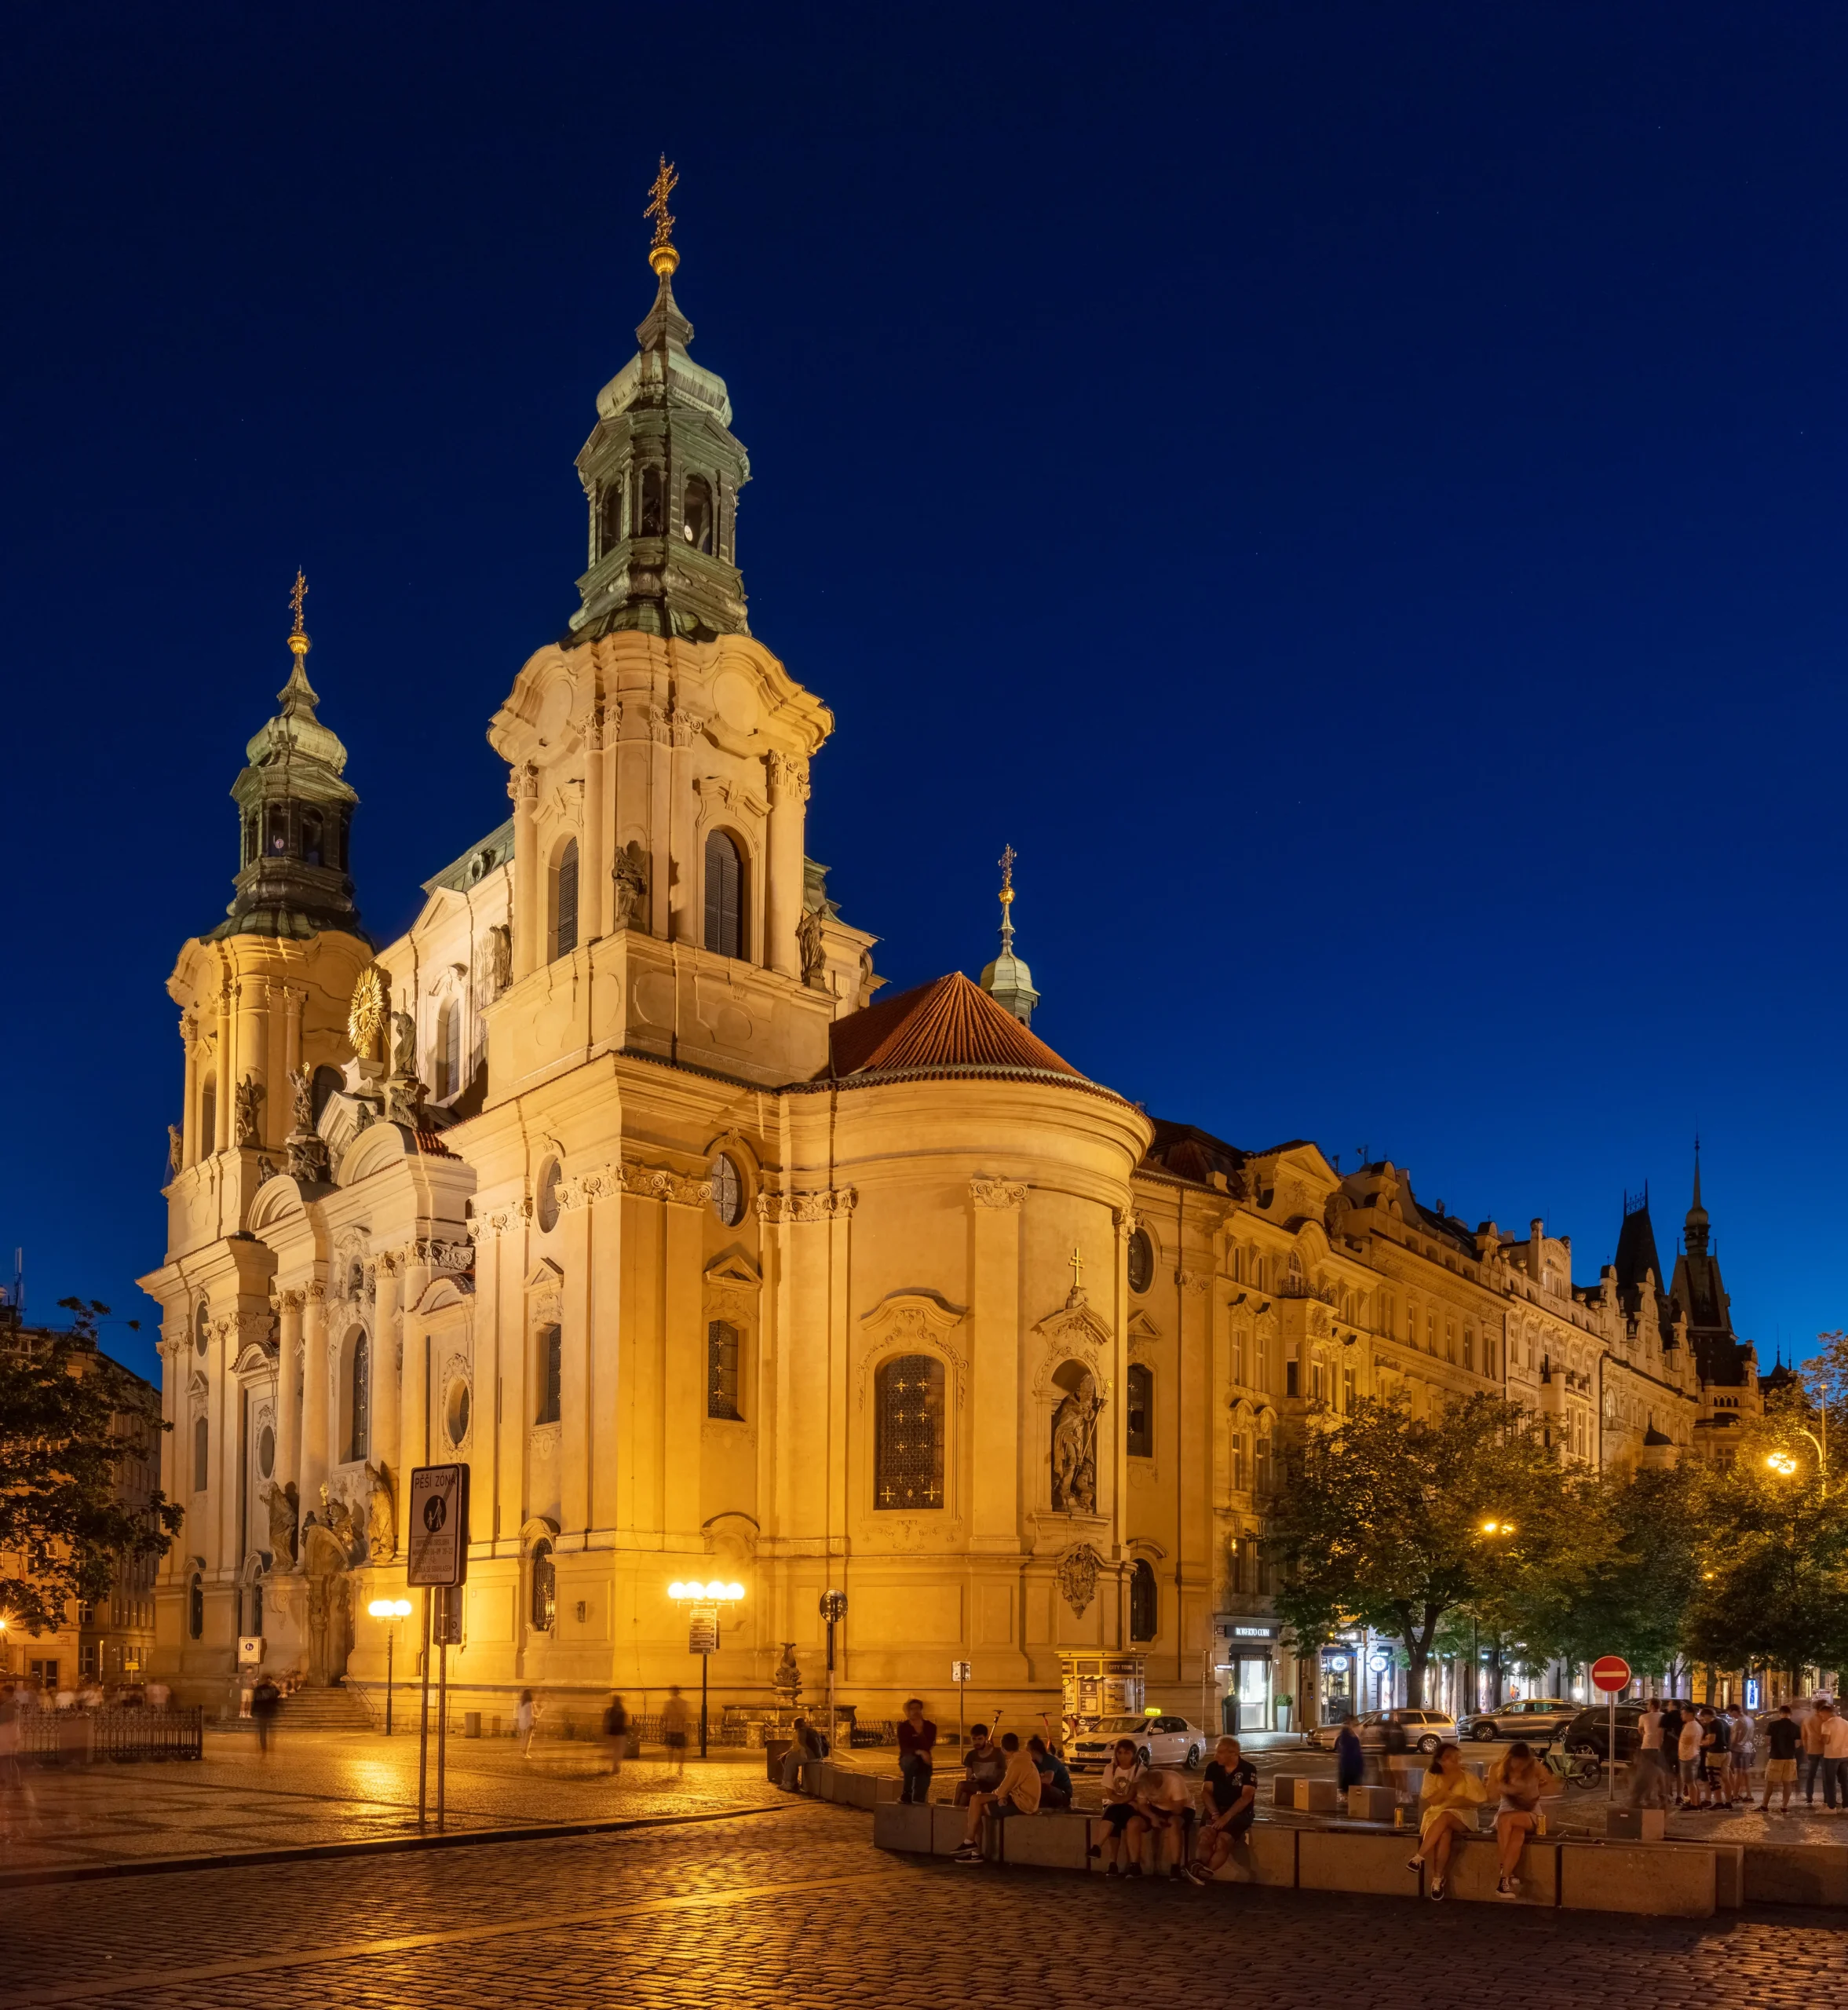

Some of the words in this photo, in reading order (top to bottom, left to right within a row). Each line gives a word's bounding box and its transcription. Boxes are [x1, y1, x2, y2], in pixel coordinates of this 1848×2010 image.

[415, 1473, 432, 1489] PĚŠÍ
[435, 1471, 456, 1487] ZÓNA
[1235, 1627, 1257, 1636] ROBERTO
[1258, 1628, 1270, 1637] COIN
